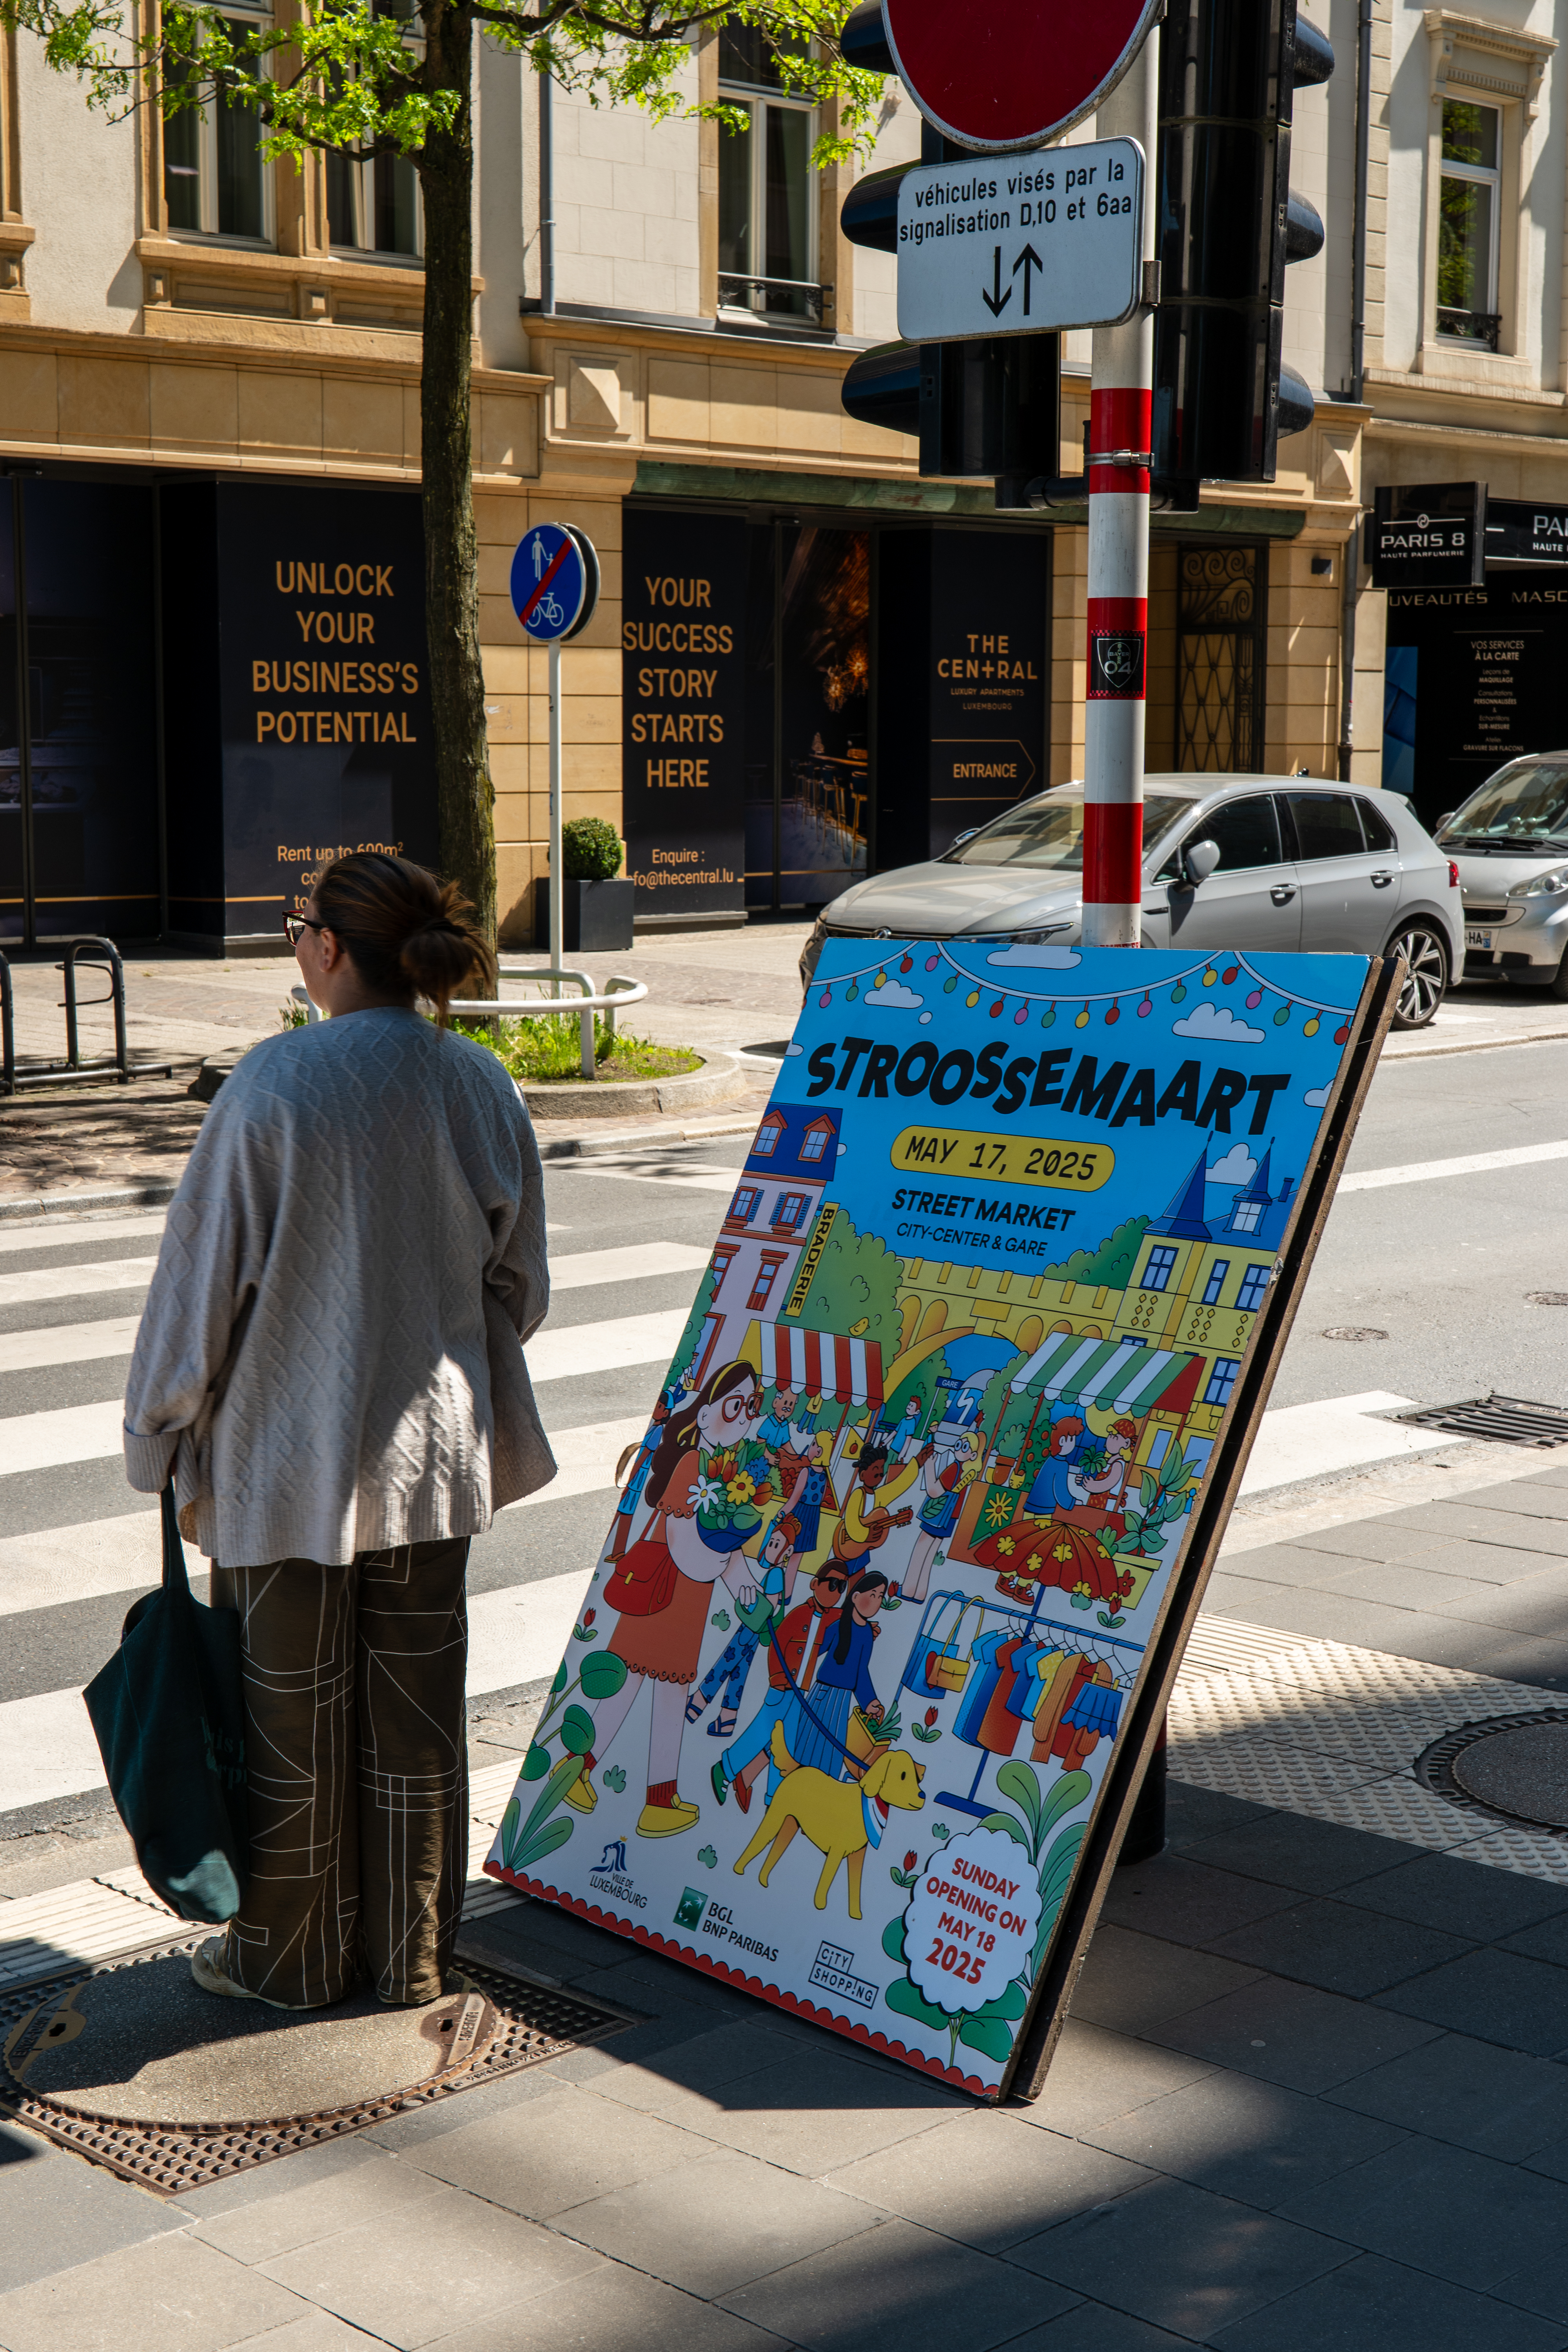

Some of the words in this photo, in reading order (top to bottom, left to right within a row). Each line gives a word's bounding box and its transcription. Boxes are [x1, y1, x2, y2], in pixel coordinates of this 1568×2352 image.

[916, 178, 997, 208] véhicules
[1008, 169, 1054, 194] visés
[1066, 167, 1096, 193] par
[1109, 158, 1124, 182] la
[900, 209, 1010, 246] signalisation
[1067, 196, 1085, 220] et
[1098, 193, 1132, 217] 6aa
[1381, 534, 1443, 548] PARIS
[1452, 533, 1465, 546] 8
[1534, 515, 1568, 537] PA
[1533, 542, 1563, 552] HAUTE
[276, 561, 394, 596] UNLOCK
[645, 576, 711, 608] YOUR
[296, 610, 375, 644] YOUR
[622, 622, 733, 654] SUCCESS
[967, 634, 1009, 654] THE
[1471, 641, 1487, 649] VOS
[1489, 641, 1524, 649] SERVICES
[1475, 650, 1481, 660] À
[1494, 652, 1519, 660] CARTE
[252, 660, 419, 694] BUSINESS'S
[638, 668, 717, 698] STORY
[1104, 661, 1132, 674] 04
[256, 711, 417, 743] POTENTIAL
[631, 713, 724, 743] STARTS
[647, 759, 709, 787] HERE
[953, 764, 1017, 778] ENTRANCE
[278, 846, 312, 862] Rent
[316, 848, 334, 862] up
[652, 848, 698, 866] Enquire
[806, 1036, 1292, 1136] STROOSSEMAART
[905, 1136, 959, 1164] MAY
[969, 1143, 1007, 1175] 17,
[1024, 1148, 1097, 1180] 2025
[892, 1189, 975, 1218] STREET
[975, 1199, 1076, 1232] MARKET
[897, 1222, 991, 1248] CITY-CENTER
[991, 1235, 1002, 1250] &
[1005, 1238, 1047, 1256] GARE
[790, 1208, 835, 1310] BRADERIE
[942, 1380, 959, 1388] GARE
[590, 1875, 647, 1908] LUXEMBOURG
[612, 1873, 626, 1885] VILLE
[625, 1879, 634, 1889] DE
[952, 1858, 1021, 1900] SUNDAY
[708, 1902, 733, 1925] BGL
[926, 1877, 998, 1922] OPENING
[999, 1911, 1027, 1936] ON
[702, 1919, 728, 1938] BNP
[728, 1930, 779, 1962] PARIBAS
[937, 1911, 976, 1942] MAY
[976, 1931, 996, 1953] 18
[925, 1937, 986, 1984] 2025
